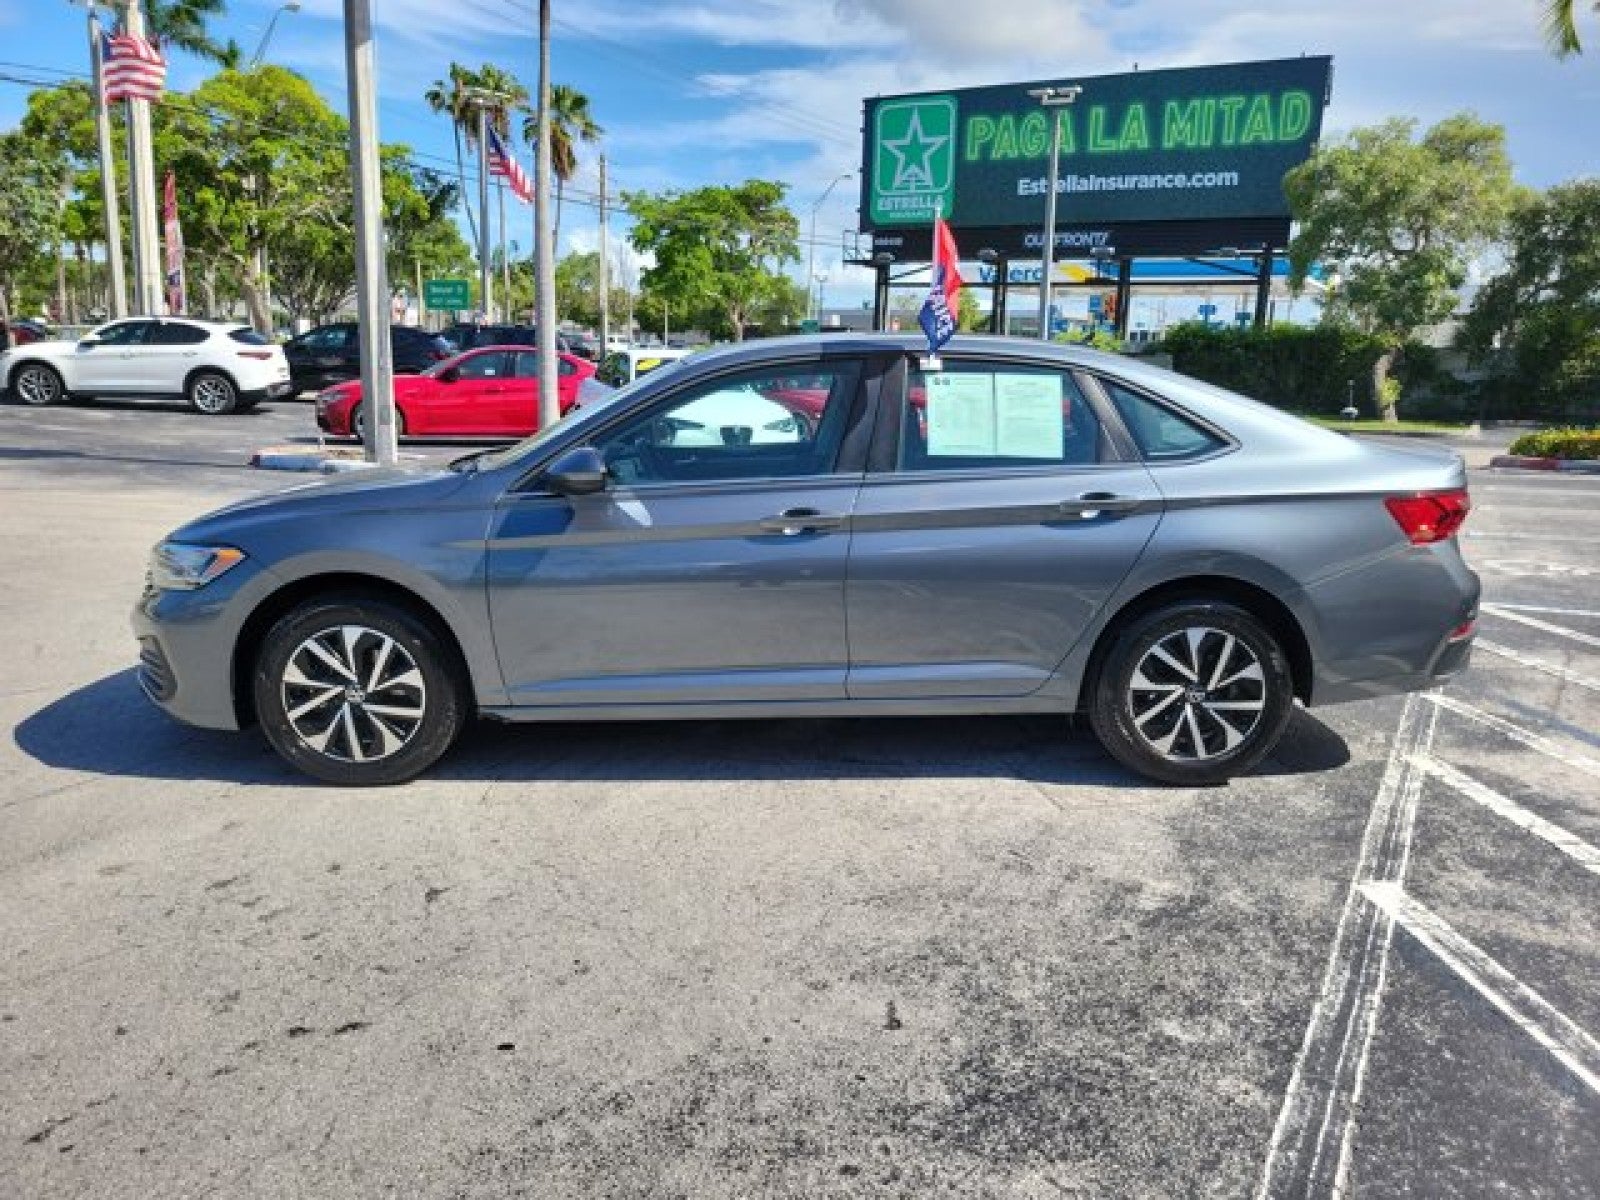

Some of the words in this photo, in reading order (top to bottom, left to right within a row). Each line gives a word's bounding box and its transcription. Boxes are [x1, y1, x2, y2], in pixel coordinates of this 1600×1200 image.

[966, 109, 1075, 160] PAGA
[1089, 104, 1149, 152] LA
[1163, 91, 1311, 149] MITAD
[1017, 171, 1239, 196] EstellaInsurance.com
[979, 266, 1043, 281] Vero
